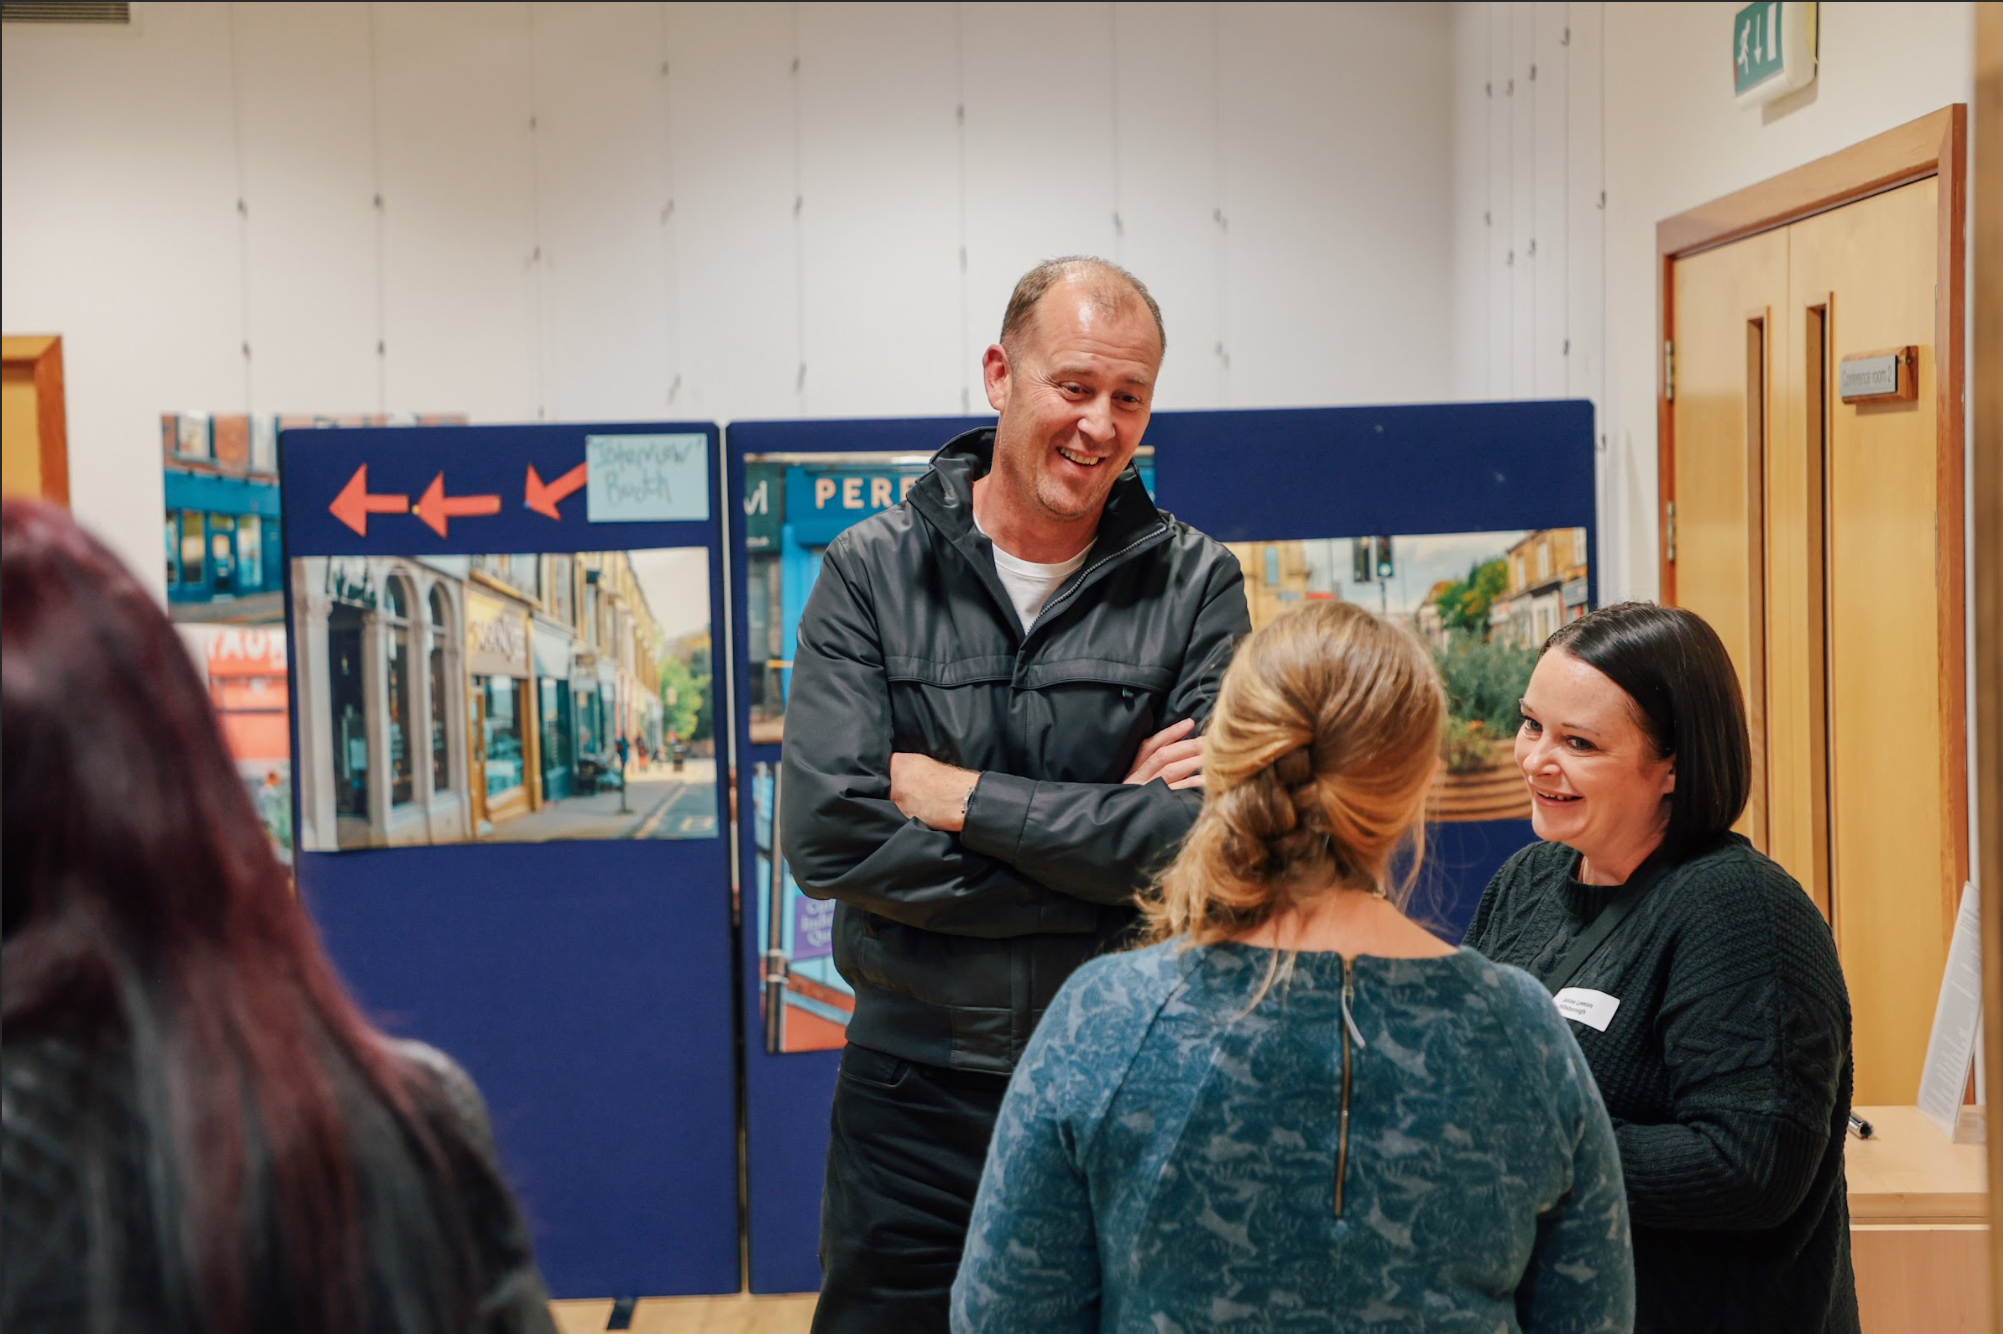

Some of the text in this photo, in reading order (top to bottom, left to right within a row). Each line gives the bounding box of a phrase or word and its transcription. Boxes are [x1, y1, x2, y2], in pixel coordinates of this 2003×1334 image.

[1842, 364, 1893, 387] Conference room 2
[604, 467, 673, 506] Booth
